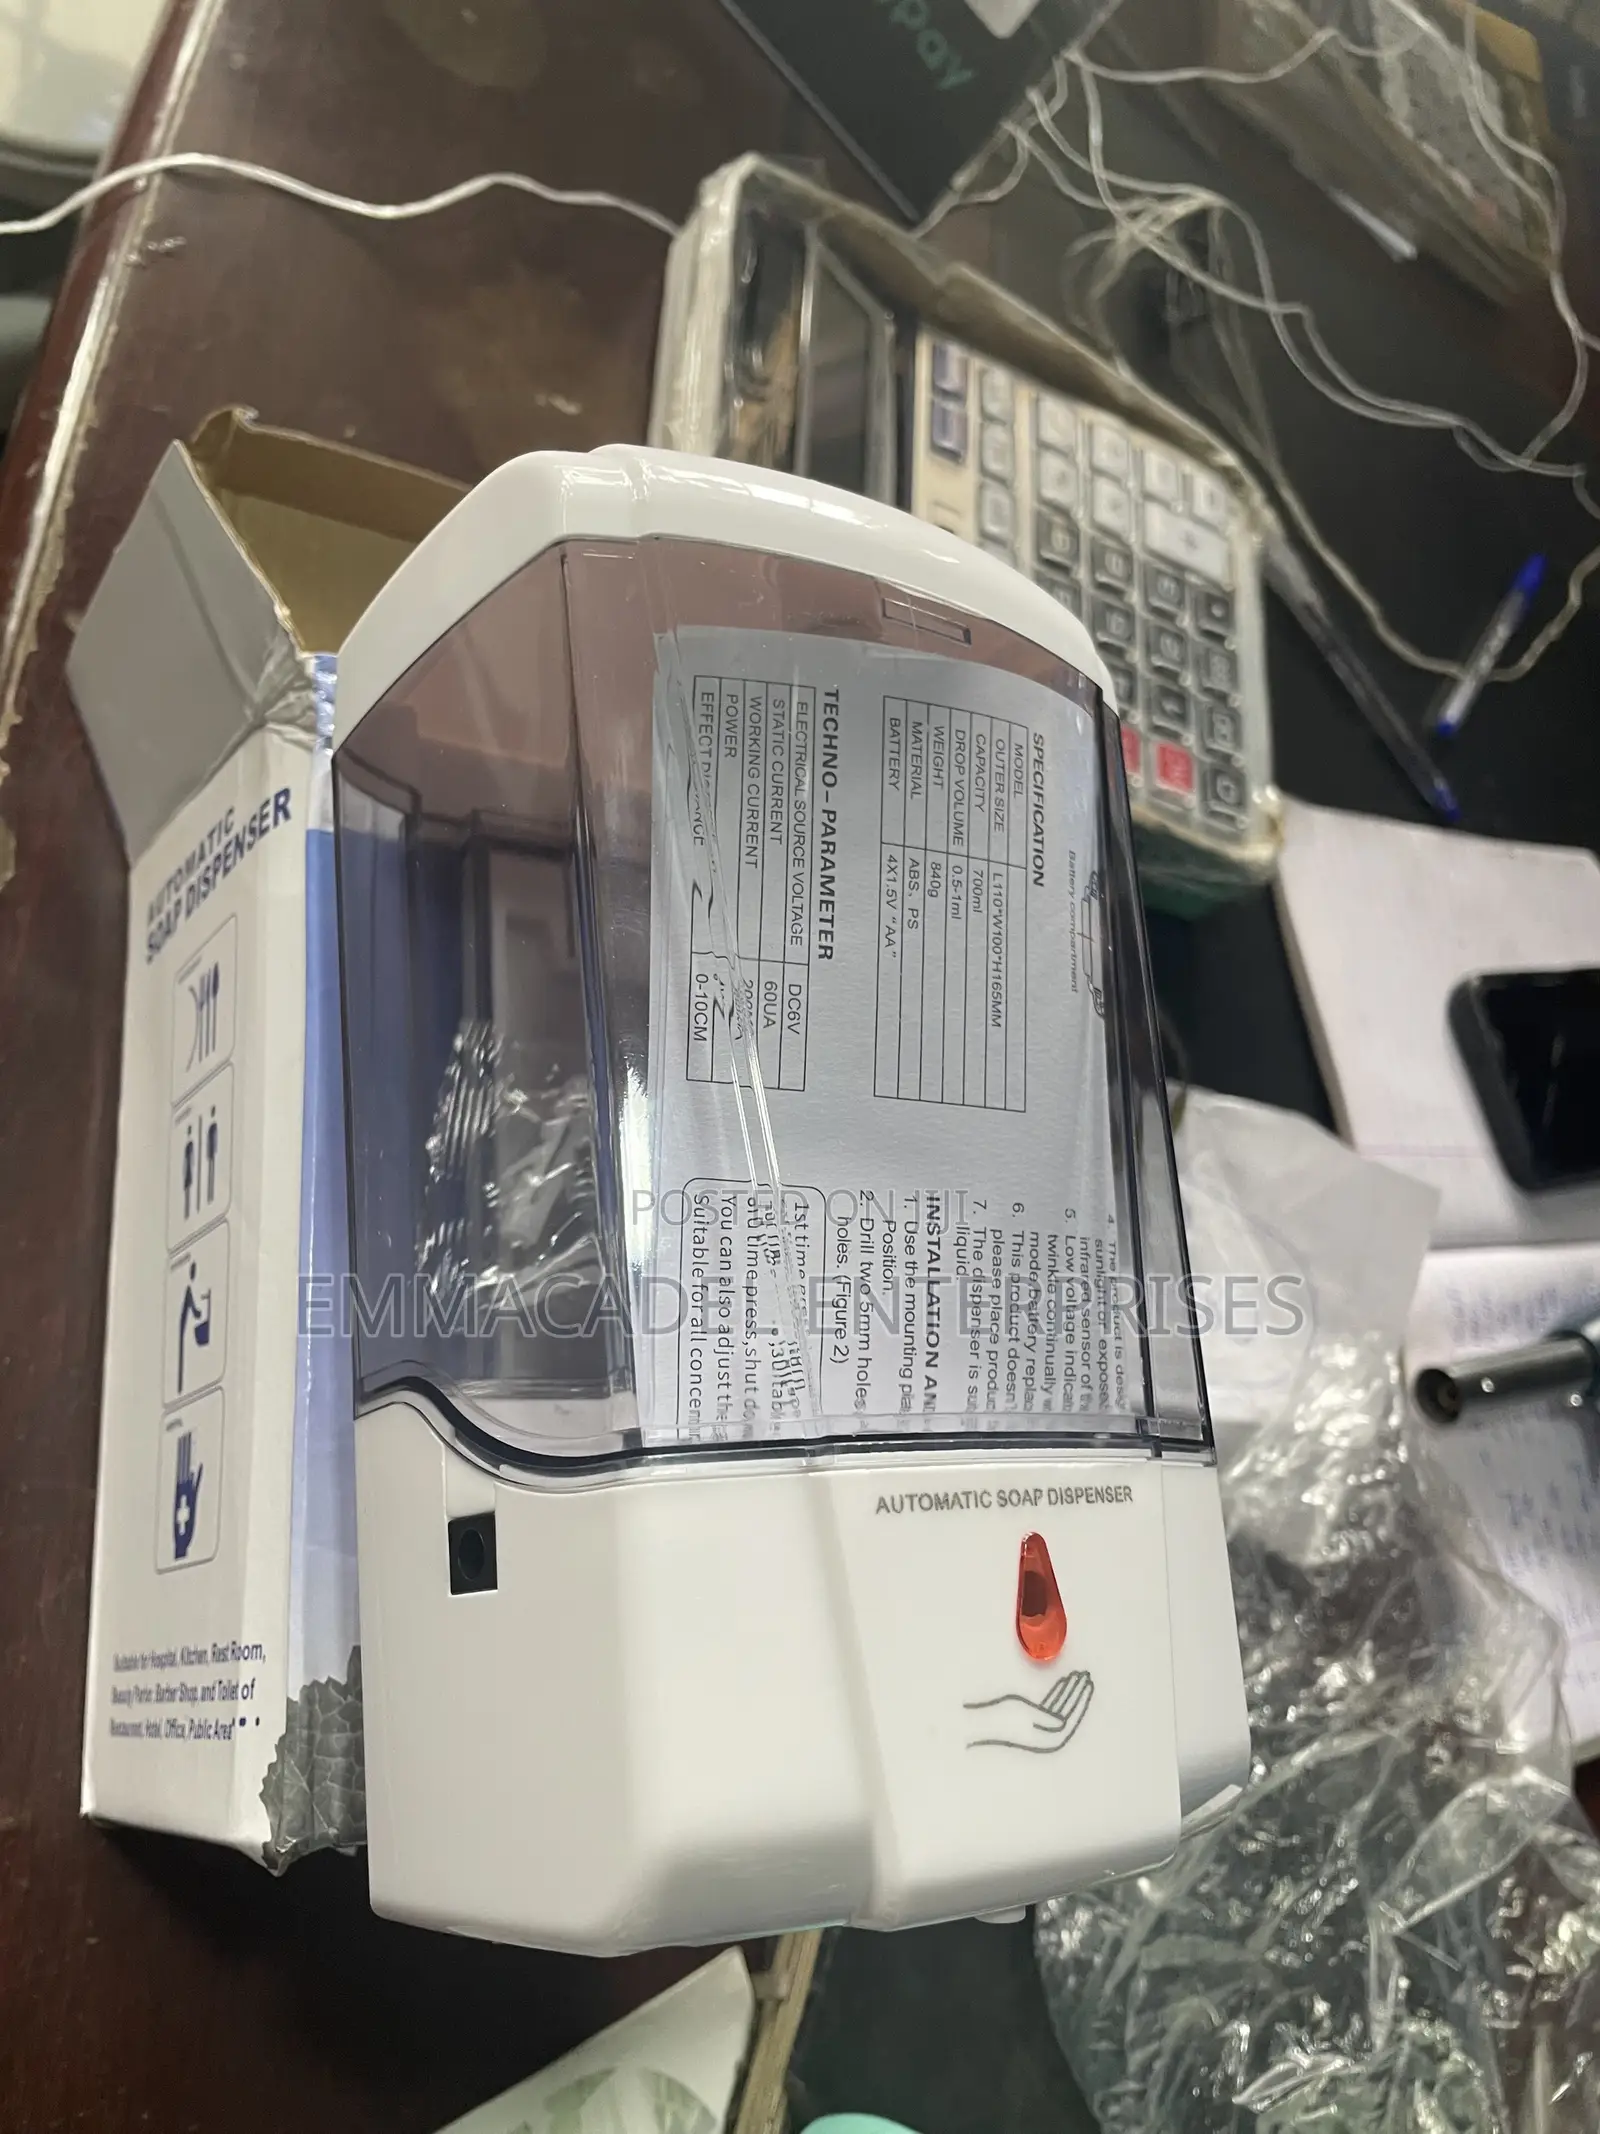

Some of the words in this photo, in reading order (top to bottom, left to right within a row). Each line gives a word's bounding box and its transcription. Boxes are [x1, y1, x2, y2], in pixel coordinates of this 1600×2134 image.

[699, 692, 714, 758] EFFECT
[724, 693, 739, 758] POWER
[748, 696, 763, 778] WORKING
[771, 699, 785, 756] STATIC
[794, 701, 808, 797] ELECTRICAL
[954, 729, 966, 776] DROP
[888, 717, 901, 791] BATTERY
[911, 721, 923, 799] MATERIAL
[932, 725, 945, 790] WEIGHT
[975, 733, 986, 812] CAPACITY
[995, 738, 1005, 794] OUTER
[1013, 743, 1024, 798] MODEL
[745, 784, 760, 868] CURRENT
[770, 761, 784, 845] CURRENT
[952, 779, 965, 846] VOLUME
[994, 796, 1005, 833] SIZE
[1032, 733, 1045, 887] SPECIFICATION
[792, 801, 806, 868] SOURCE
[147, 898, 182, 965] SOAP
[186, 787, 292, 921] DISPENSER
[818, 809, 837, 960] PARAMETER
[885, 854, 899, 910] 4X1.5V
[927, 861, 942, 898] 840g
[951, 865, 963, 920] 0.5-1ml
[972, 869, 983, 914] 700ml
[790, 872, 804, 946] VOLTAGE
[907, 907, 919, 930] PS
[693, 973, 709, 1042] 0-10CM
[763, 980, 778, 1029] 60UA
[787, 984, 802, 1035] DC6V
[720, 1196, 737, 1230] You
[860, 1190, 875, 1206] 2.
[904, 1196, 918, 1209] 1.
[973, 1200, 987, 1214] 7.
[1012, 1202, 1025, 1218] 6.
[1064, 1208, 1076, 1224] 5.
[719, 1236, 733, 1271] can
[836, 1216, 852, 1268] holes.
[860, 1218, 875, 1254] Drill
[882, 1220, 897, 1296] Position.
[904, 1221, 918, 1256] Use
[953, 1226, 971, 1280] liquid.
[972, 1227, 987, 1261] The
[990, 1229, 1005, 1289] please
[1011, 1230, 1025, 1268] This
[1065, 1235, 1076, 1273] Low
[860, 1261, 874, 1295] two
[904, 1261, 919, 1288] the
[925, 1197, 941, 1368] INSTALLATION
[1047, 1234, 1059, 1294] twinkle
[1080, 1237, 1092, 1302] infrared
[1094, 1240, 1107, 1306] sunlight
[691, 1283, 709, 1311] for
[718, 1277, 736, 1318] also
[832, 1275, 852, 1340] (Figure
[969, 1267, 985, 1359] dispenser
[988, 1294, 1003, 1345] place
[1007, 1273, 1021, 1343] product
[1063, 1277, 1077, 1345] voltage
[690, 1317, 707, 1342] all
[858, 1301, 874, 1351] 5mm
[899, 1293, 917, 1379] mounting
[1041, 1299, 1058, 1395] continually
[1081, 1308, 1091, 1370] sensor
[714, 1324, 735, 1389] adjust
[830, 1345, 850, 1363] 2)
[968, 1365, 982, 1379] is
[1081, 1375, 1093, 1391] of
[876, 1488, 993, 1515] AUTOMATIC
[996, 1488, 1044, 1508] SOAP
[1047, 1485, 1134, 1506] DISPENSER
[231, 1640, 267, 1664] Room,
[241, 1677, 256, 1701] of
